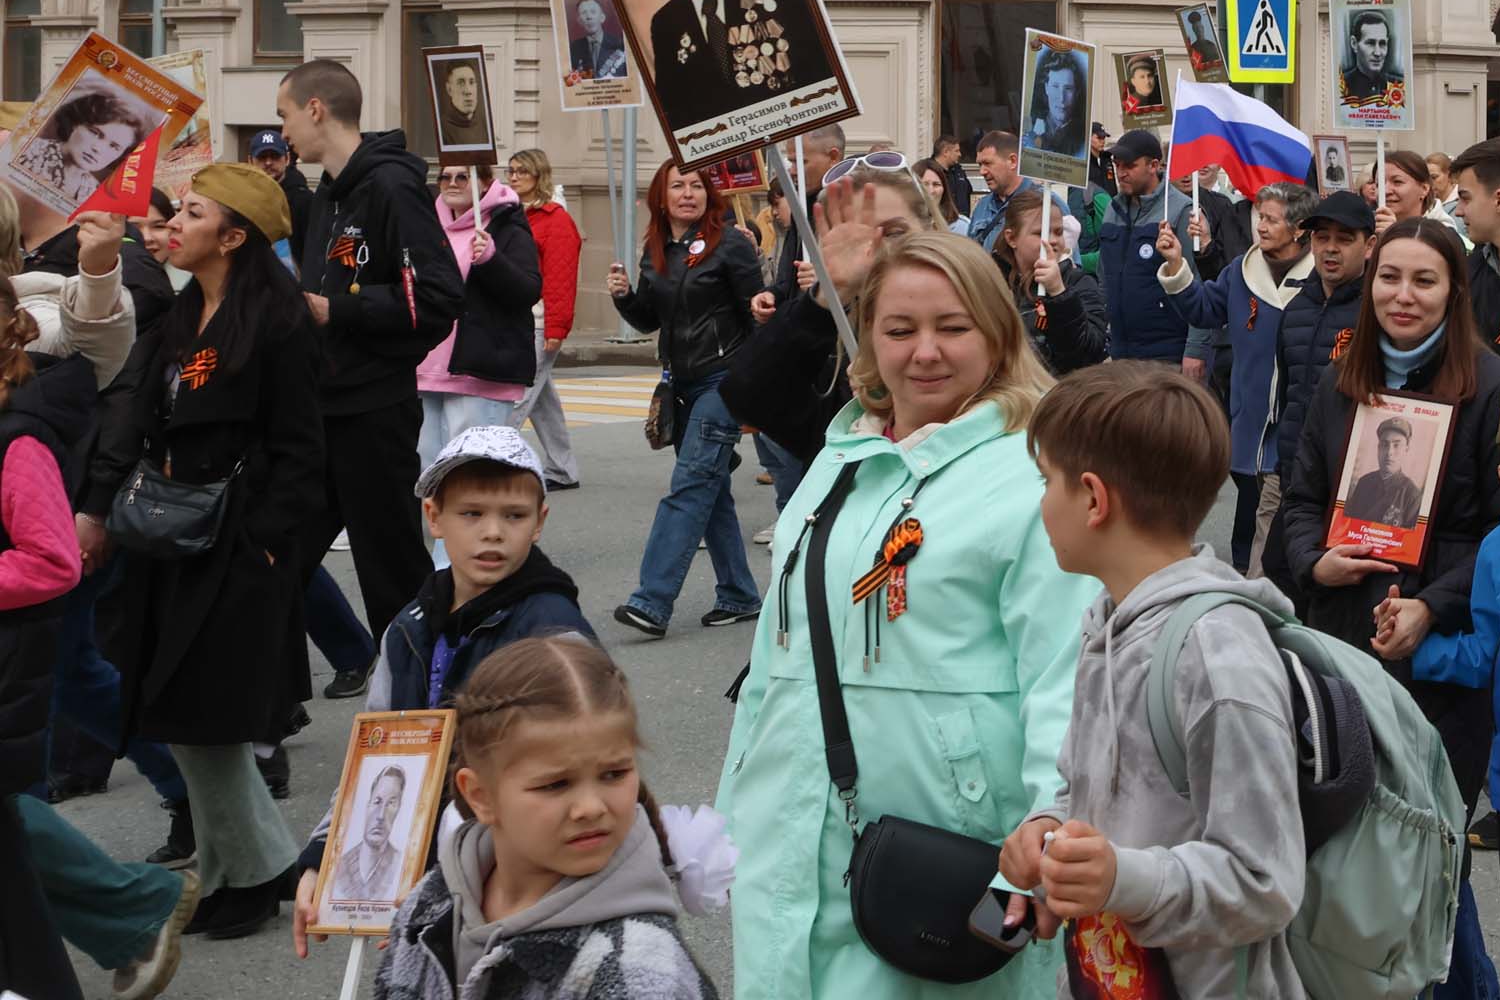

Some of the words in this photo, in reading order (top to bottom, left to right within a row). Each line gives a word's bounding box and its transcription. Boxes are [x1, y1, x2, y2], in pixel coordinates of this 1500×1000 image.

[126, 66, 178, 102] БЕССМЕРТНЫЙ
[689, 130, 747, 156] Александр
[748, 100, 839, 136] Ксенофонтович
[728, 101, 788, 128] Герасимов
